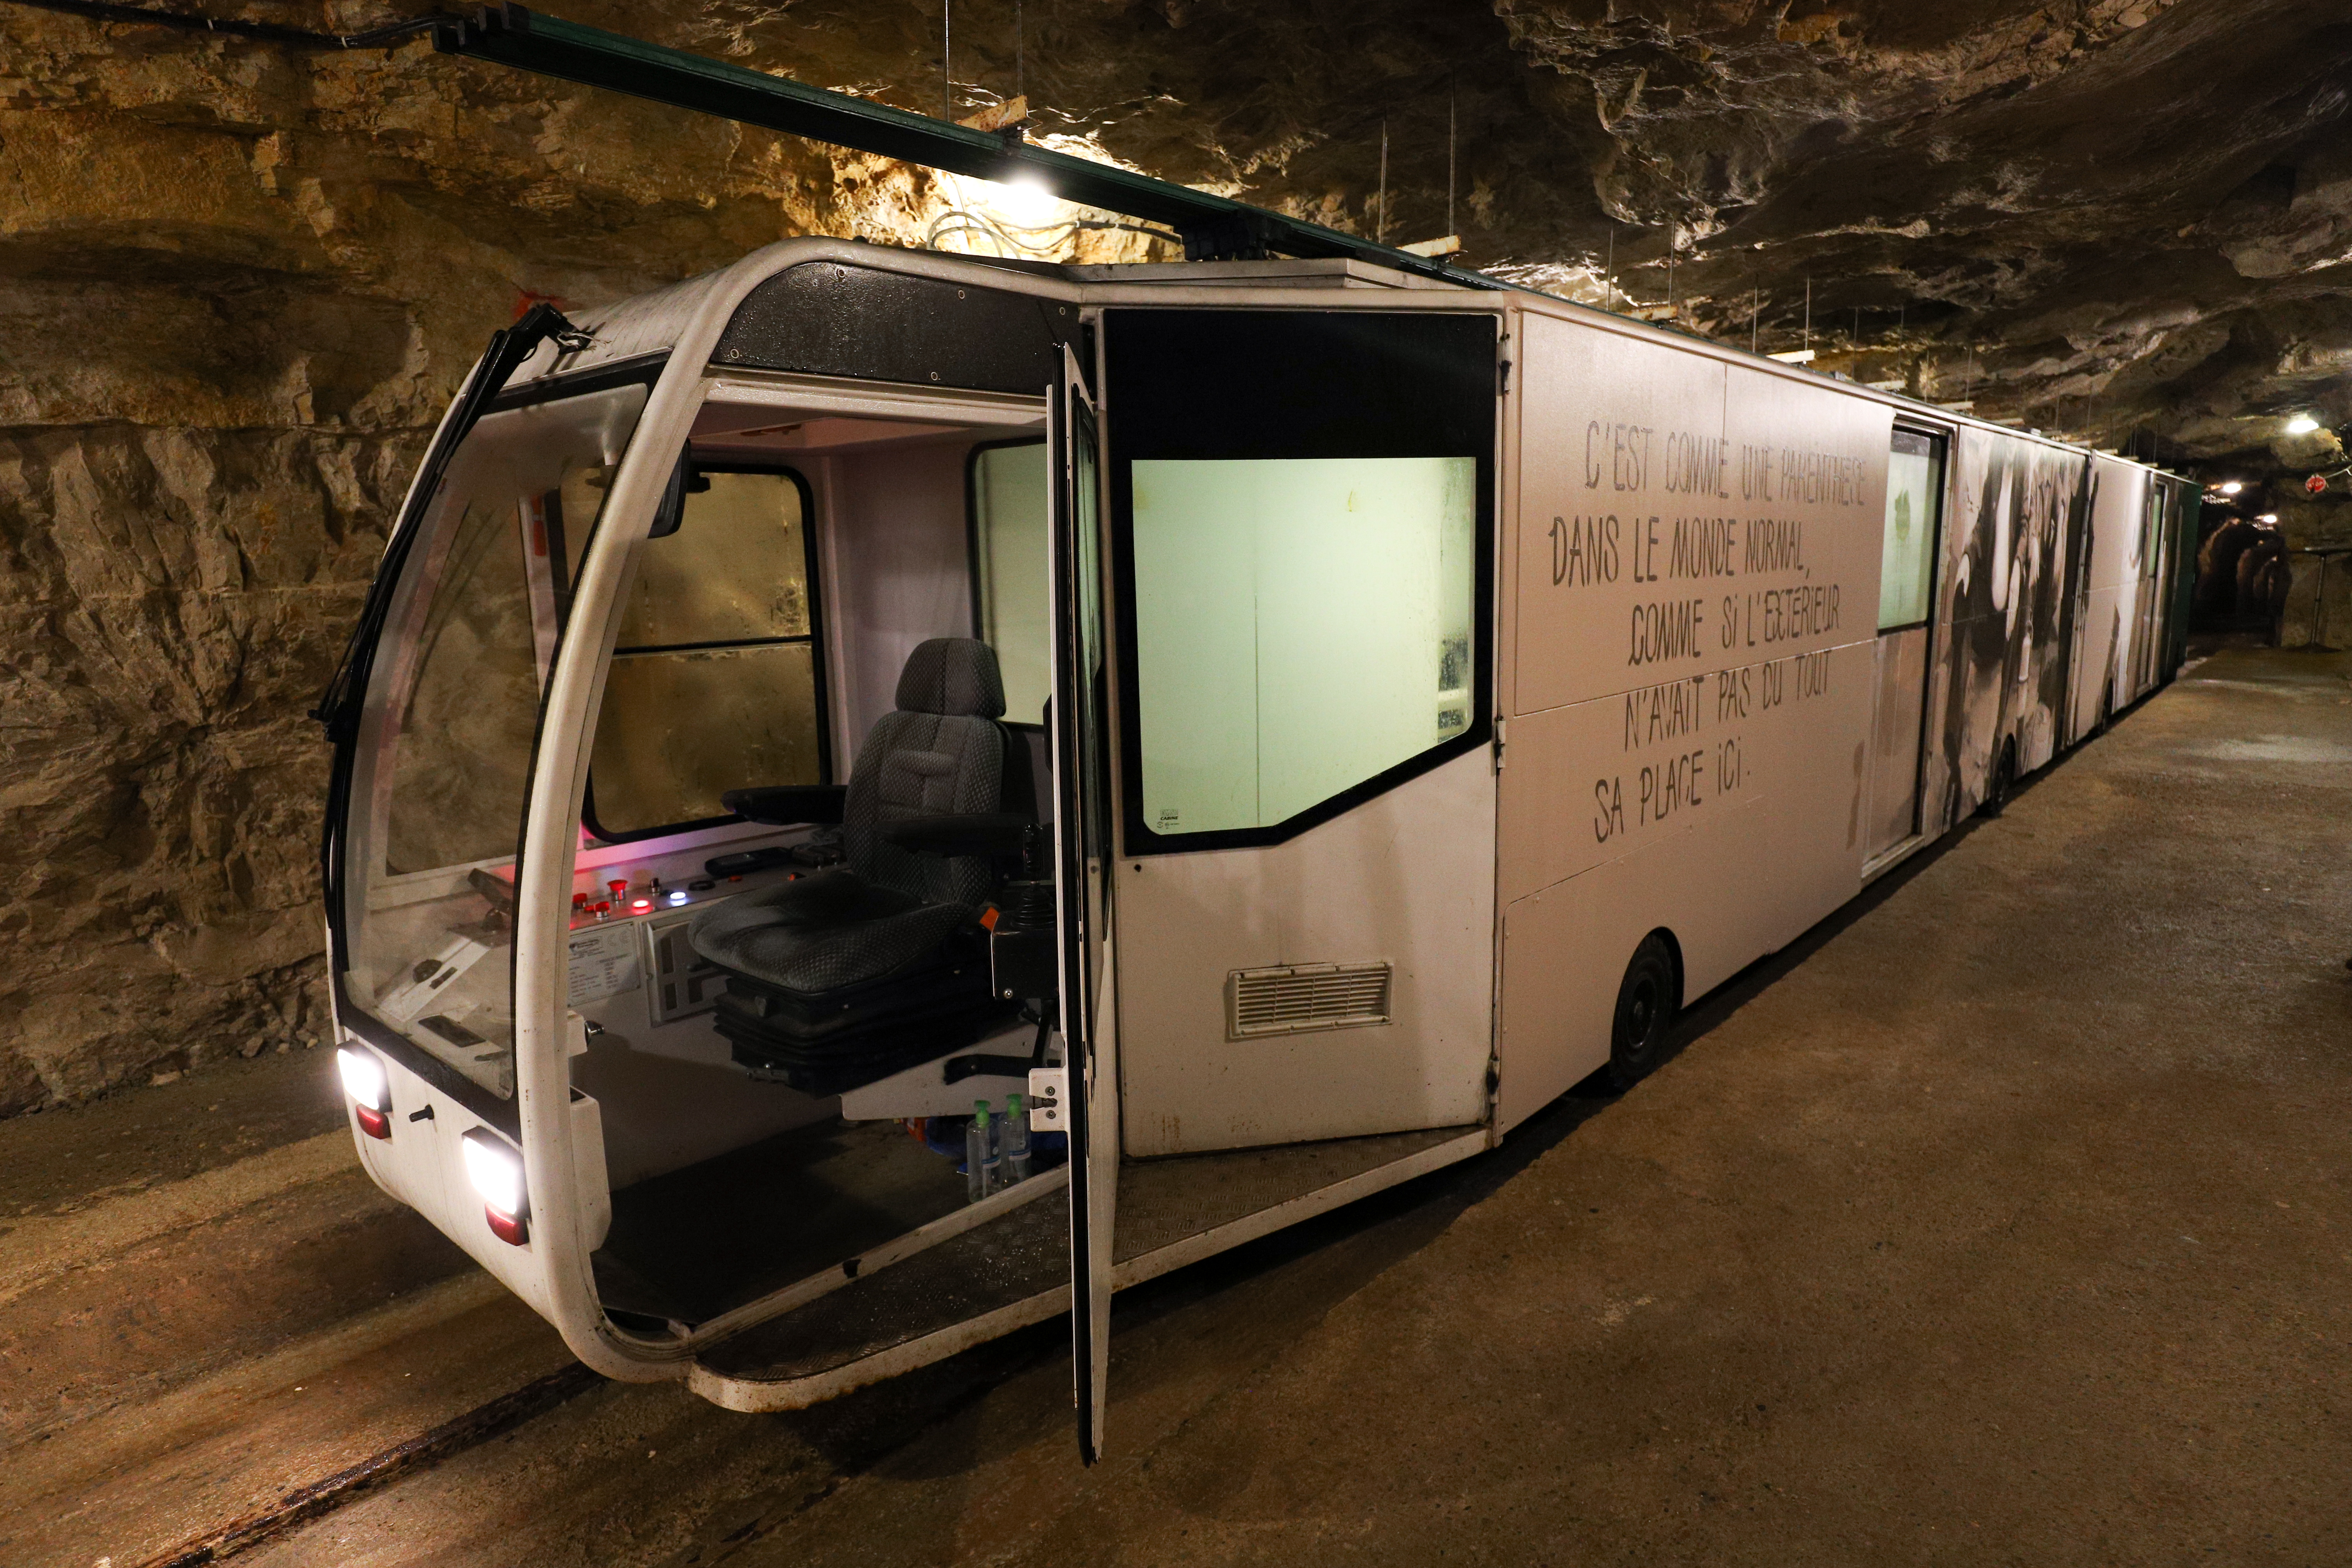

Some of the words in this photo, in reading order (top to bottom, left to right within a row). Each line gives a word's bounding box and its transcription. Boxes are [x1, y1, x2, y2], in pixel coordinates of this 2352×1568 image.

[1585, 420, 1653, 492] C'EST
[1665, 432, 1729, 499] COMME
[1742, 444, 1774, 501] UNE
[1548, 514, 1620, 588] DANS
[1634, 516, 1660, 583] LE
[1669, 517, 1737, 579] MONDE
[1745, 517, 1810, 579] NORMAL,
[1628, 599, 1703, 666] COMME
[1718, 667, 1751, 723] PAS
[1763, 661, 1782, 710] DU
[1795, 650, 1832, 701] TOUT
[1595, 776, 1624, 843] SA
[1639, 750, 1704, 827] PLACE
